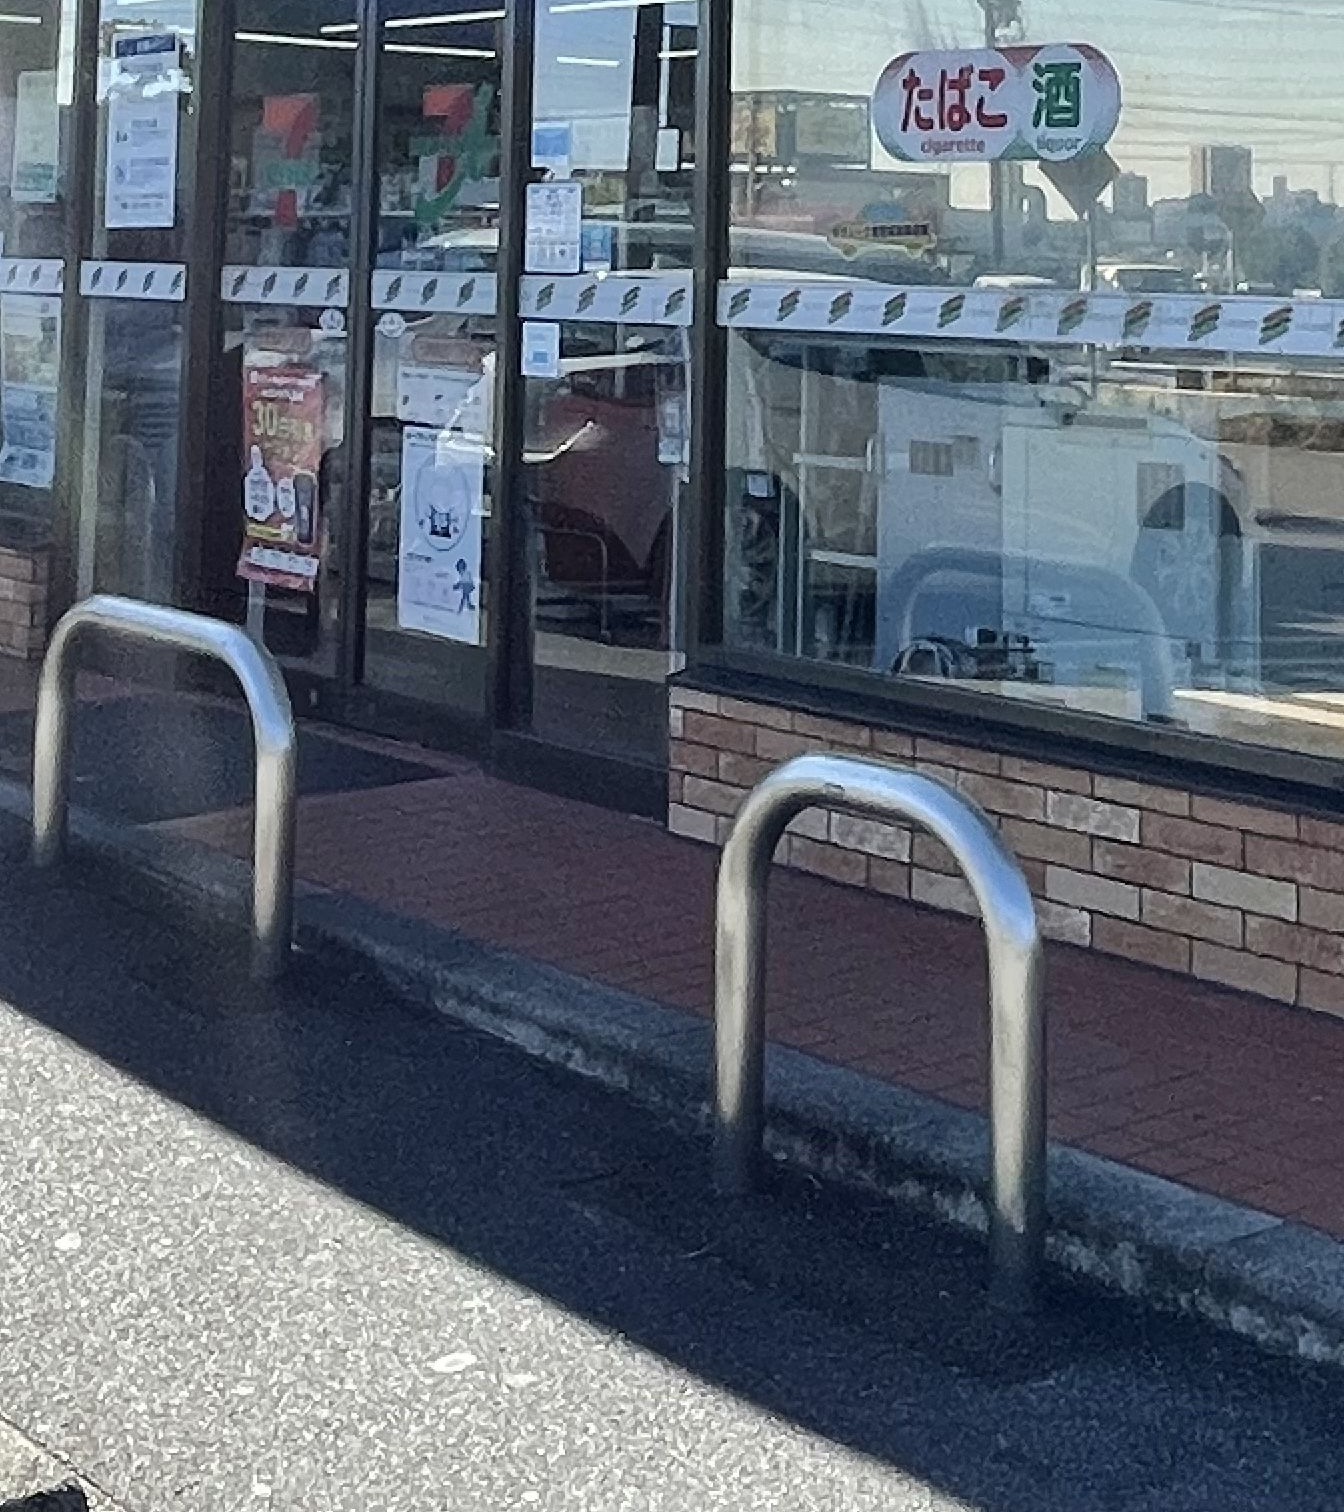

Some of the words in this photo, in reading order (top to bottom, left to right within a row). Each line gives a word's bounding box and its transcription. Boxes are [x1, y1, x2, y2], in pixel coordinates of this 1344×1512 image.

[900, 62, 1008, 132] たばこ
[1031, 62, 1082, 129] 酒
